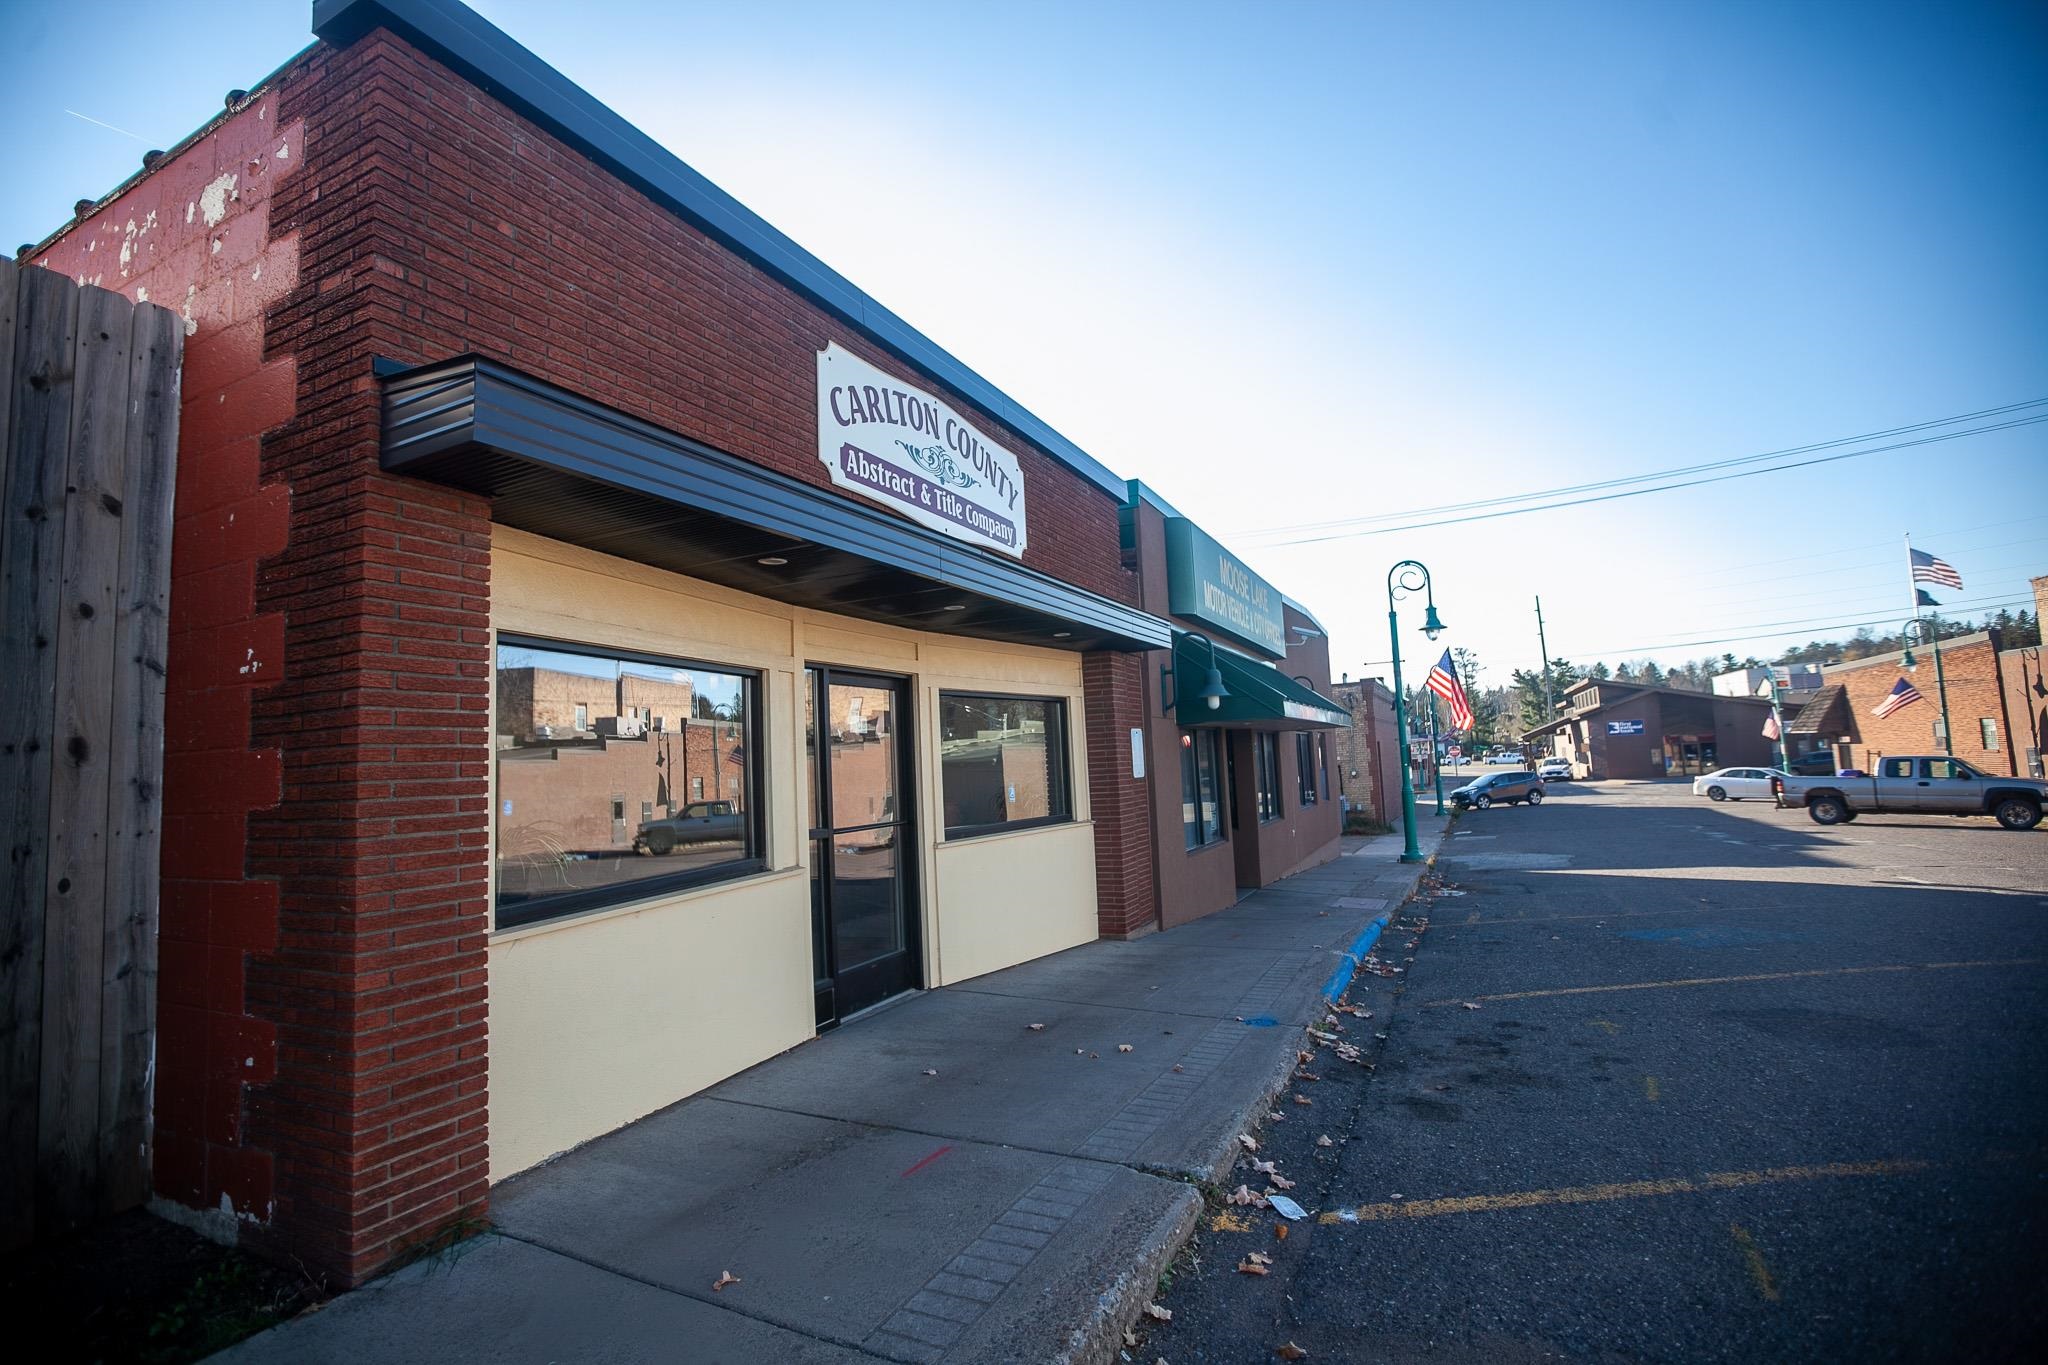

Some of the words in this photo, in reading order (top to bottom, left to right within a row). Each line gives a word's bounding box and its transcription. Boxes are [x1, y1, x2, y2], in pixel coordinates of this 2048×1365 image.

[830, 385, 940, 440] CARLTON
[945, 418, 1018, 511] COUNTY
[847, 449, 916, 499] Abstract
[920, 482, 931, 506] &
[934, 488, 963, 520] Title
[965, 503, 1013, 546] Company
[1203, 579, 1228, 617] MOTOR
[1227, 593, 1250, 630] VEHICLE
[1219, 555, 1249, 601] MOOSE
[1250, 578, 1269, 613] LAKE
